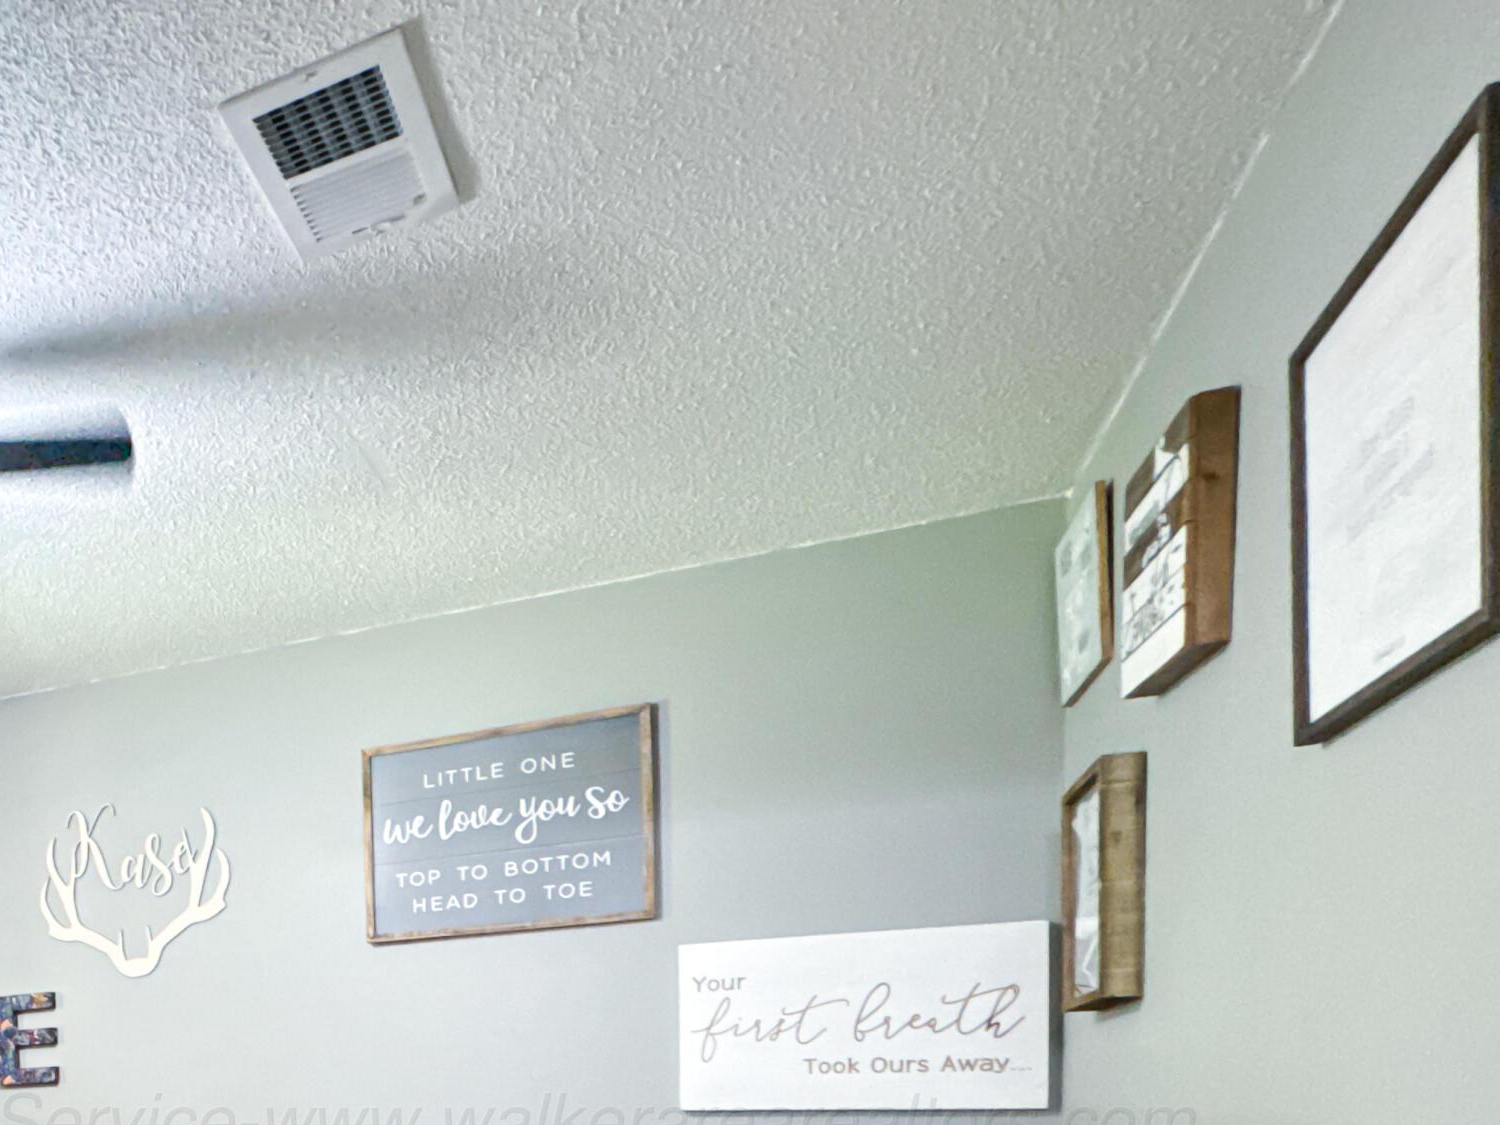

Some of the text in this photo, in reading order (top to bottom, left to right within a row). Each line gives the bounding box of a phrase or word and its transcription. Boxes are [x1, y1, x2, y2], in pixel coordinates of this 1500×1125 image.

[422, 751, 576, 789] LITTLE ONE
[382, 813, 433, 844] we
[437, 799, 513, 840] love
[514, 794, 581, 844] you
[396, 851, 612, 888] TOP TO BOTTOM
[412, 881, 594, 914] HEAD TO TOE
[691, 974, 746, 994] Your
[691, 982, 1026, 1063] first breath
[803, 1056, 861, 1075] Took
[870, 1055, 930, 1074] Ours
